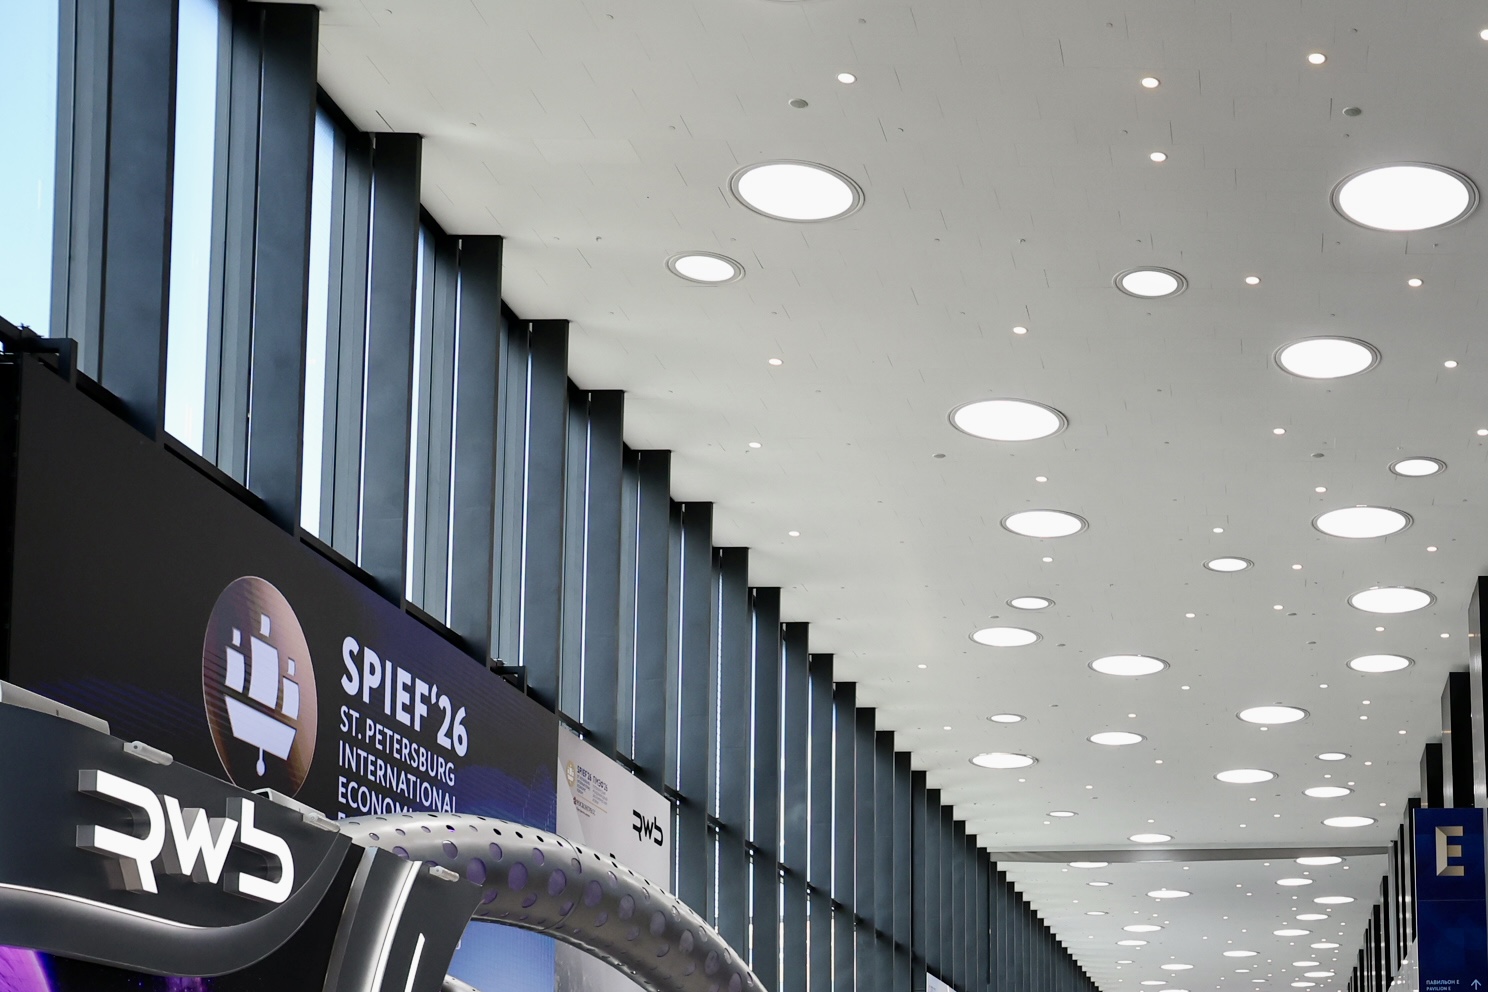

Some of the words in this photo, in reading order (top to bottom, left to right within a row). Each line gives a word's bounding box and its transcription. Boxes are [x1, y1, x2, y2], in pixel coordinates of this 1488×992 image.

[339, 705, 362, 739] ST.
[365, 718, 455, 786] PETERSBURG
[1435, 826, 1465, 876] E
